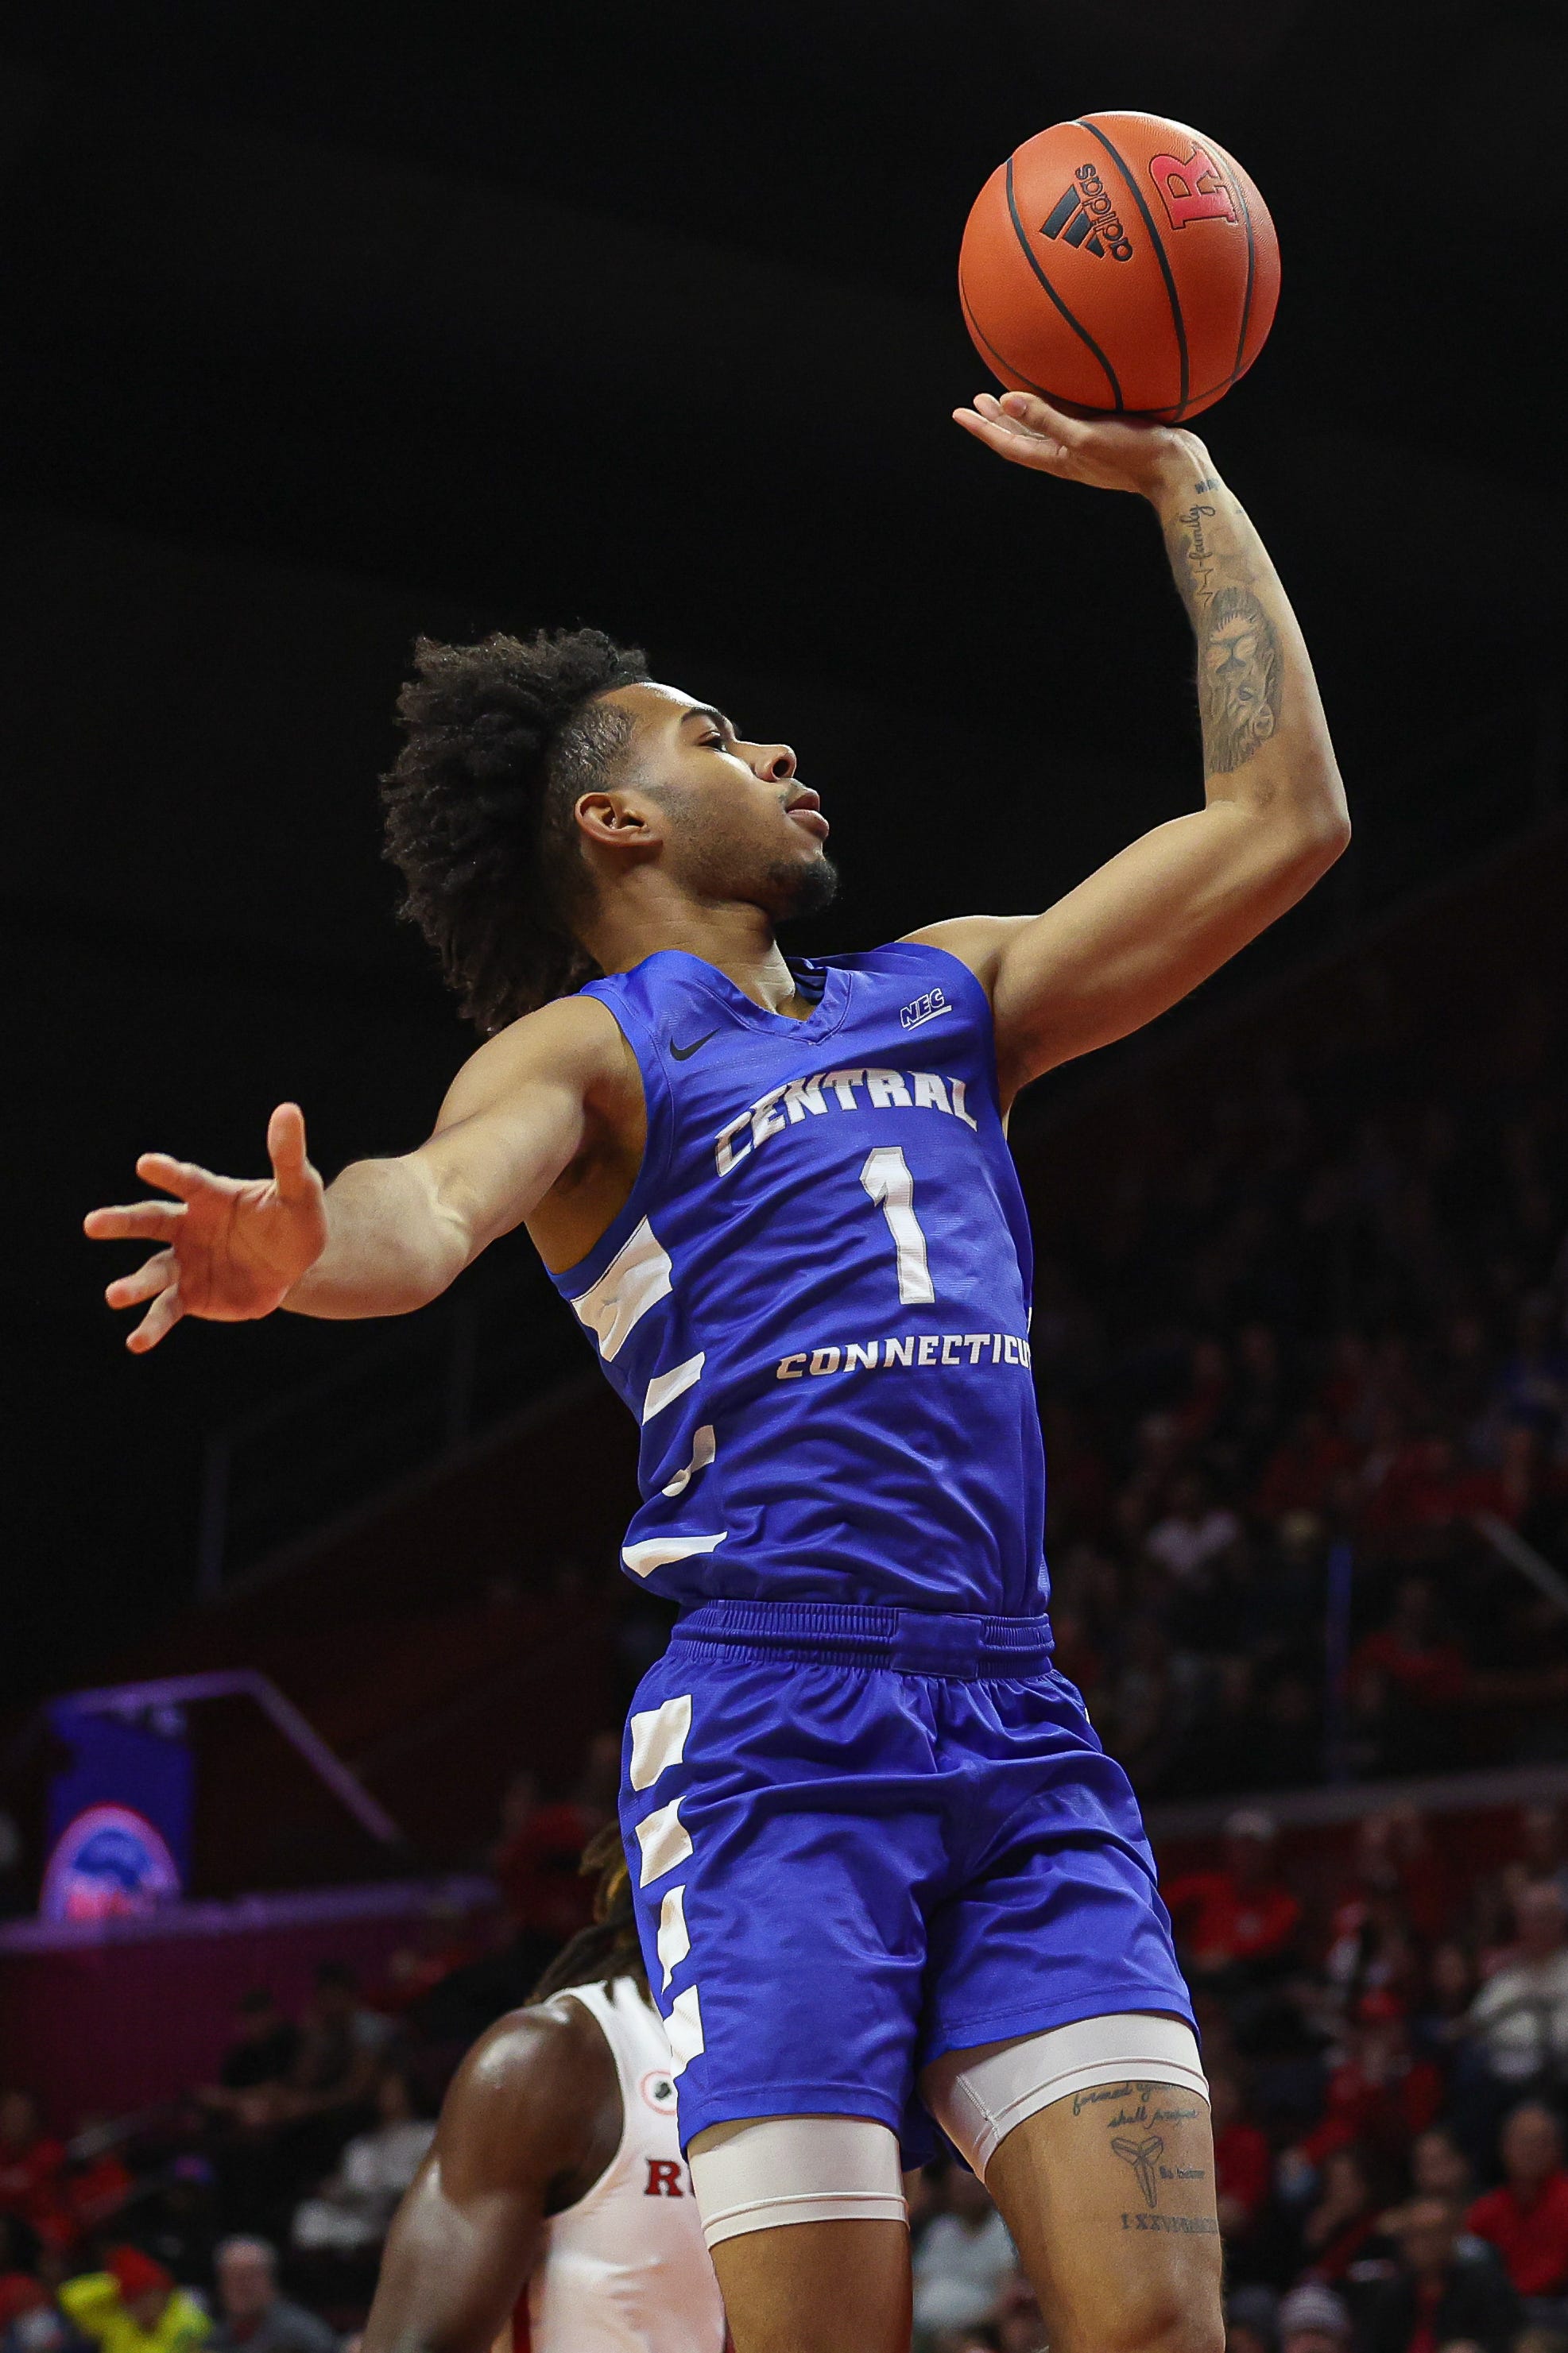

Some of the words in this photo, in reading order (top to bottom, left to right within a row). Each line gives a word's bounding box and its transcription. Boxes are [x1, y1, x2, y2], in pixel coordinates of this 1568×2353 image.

[1075, 164, 1133, 261] adidas
[1148, 141, 1238, 231] R
[900, 988, 947, 1028] NEC
[715, 1068, 978, 1178] CENTRAL
[859, 1146, 935, 1305] 1
[645, 2159, 694, 2198] R
